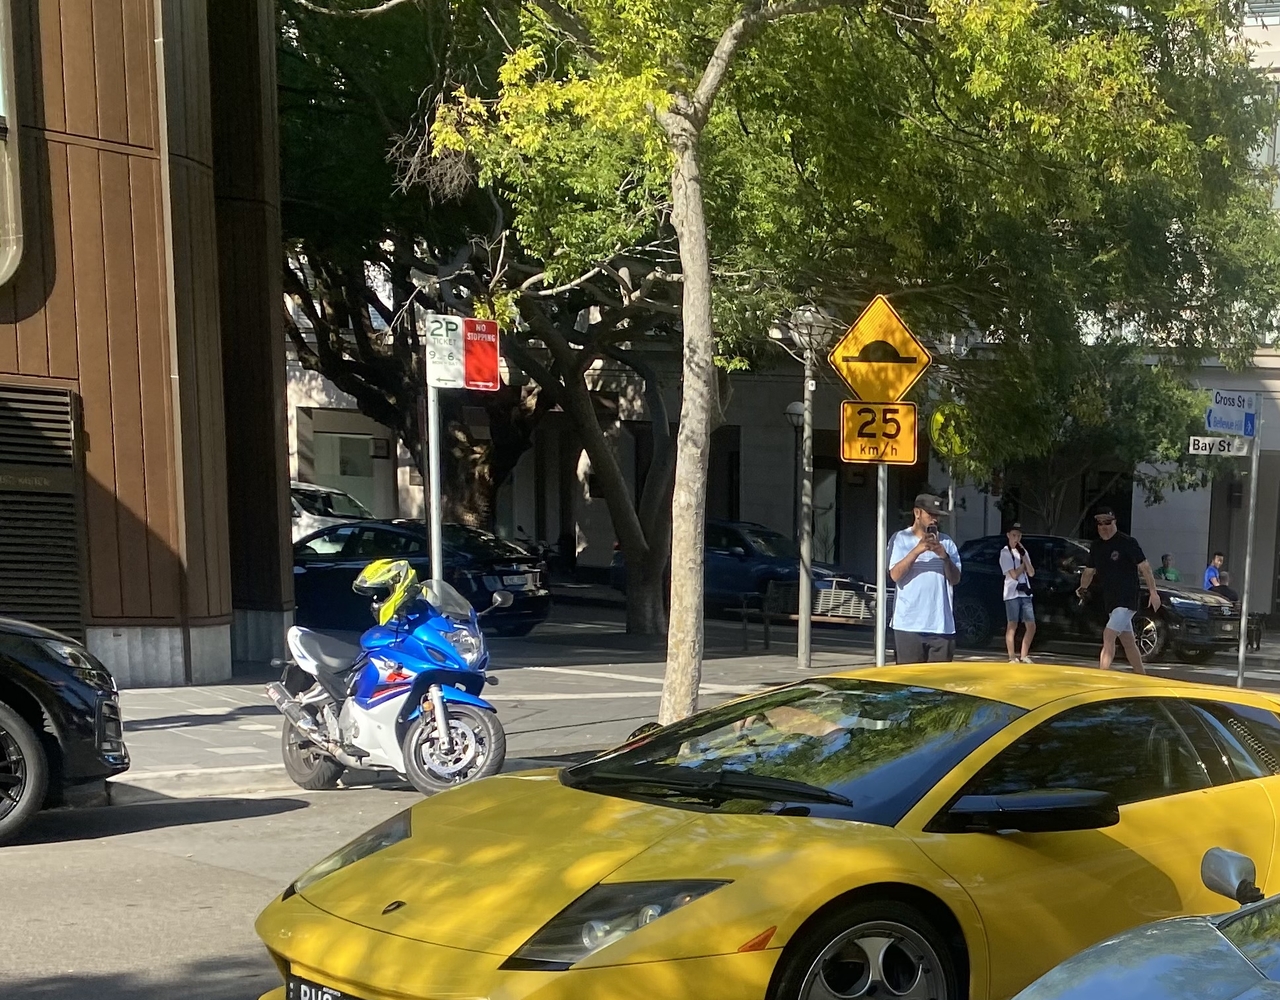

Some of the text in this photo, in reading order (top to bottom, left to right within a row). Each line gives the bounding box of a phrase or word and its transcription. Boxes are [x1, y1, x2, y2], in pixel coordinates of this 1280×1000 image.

[430, 320, 458, 337] 2P
[476, 324, 487, 332] NO
[432, 338, 457, 346] TICKET
[467, 333, 496, 342] STOPPING
[1215, 391, 1245, 408] Cross St
[857, 408, 901, 440] 25
[860, 442, 898, 458] km/h
[1193, 439, 1231, 454] Bay St
